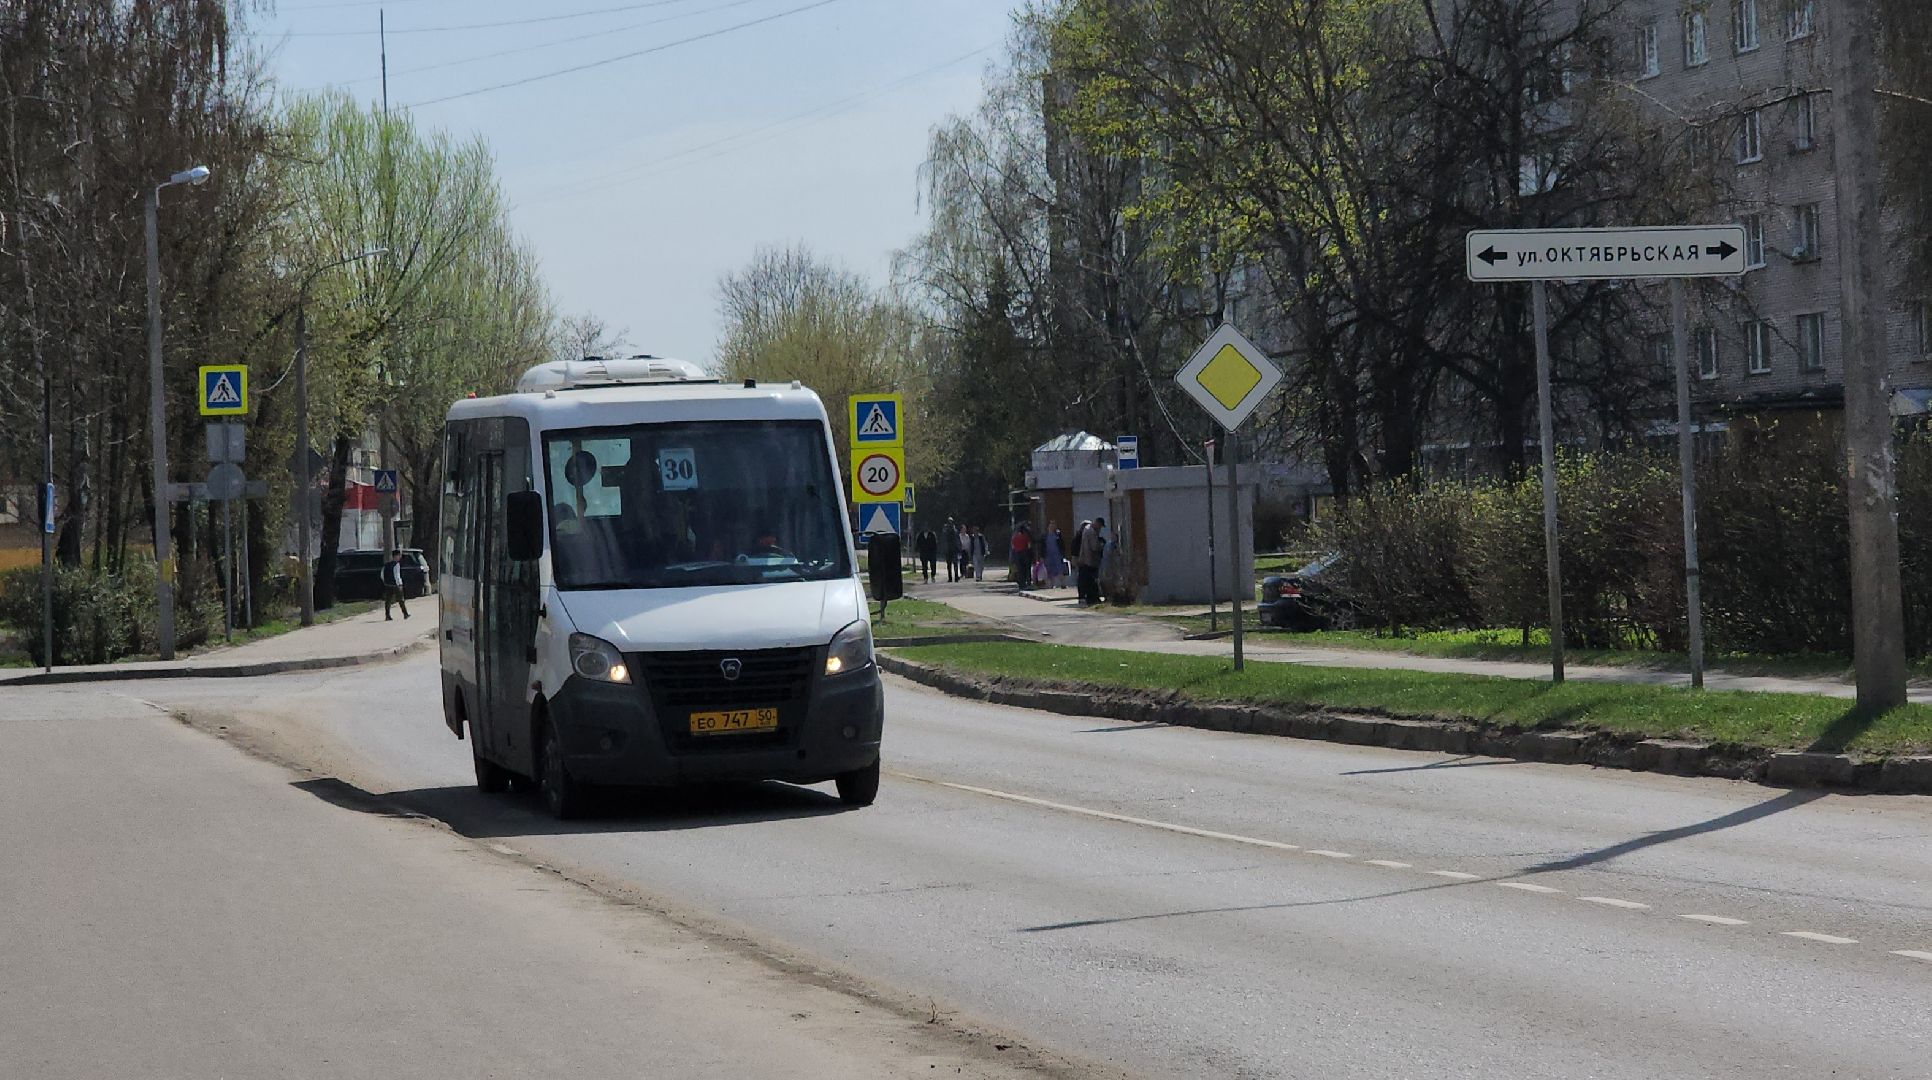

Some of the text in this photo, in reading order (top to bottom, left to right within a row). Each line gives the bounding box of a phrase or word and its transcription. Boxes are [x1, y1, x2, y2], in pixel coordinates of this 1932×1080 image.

[664, 458, 693, 481] 30
[867, 466, 889, 483] 20
[721, 712, 749, 727] 747
[758, 709, 772, 721] 50
